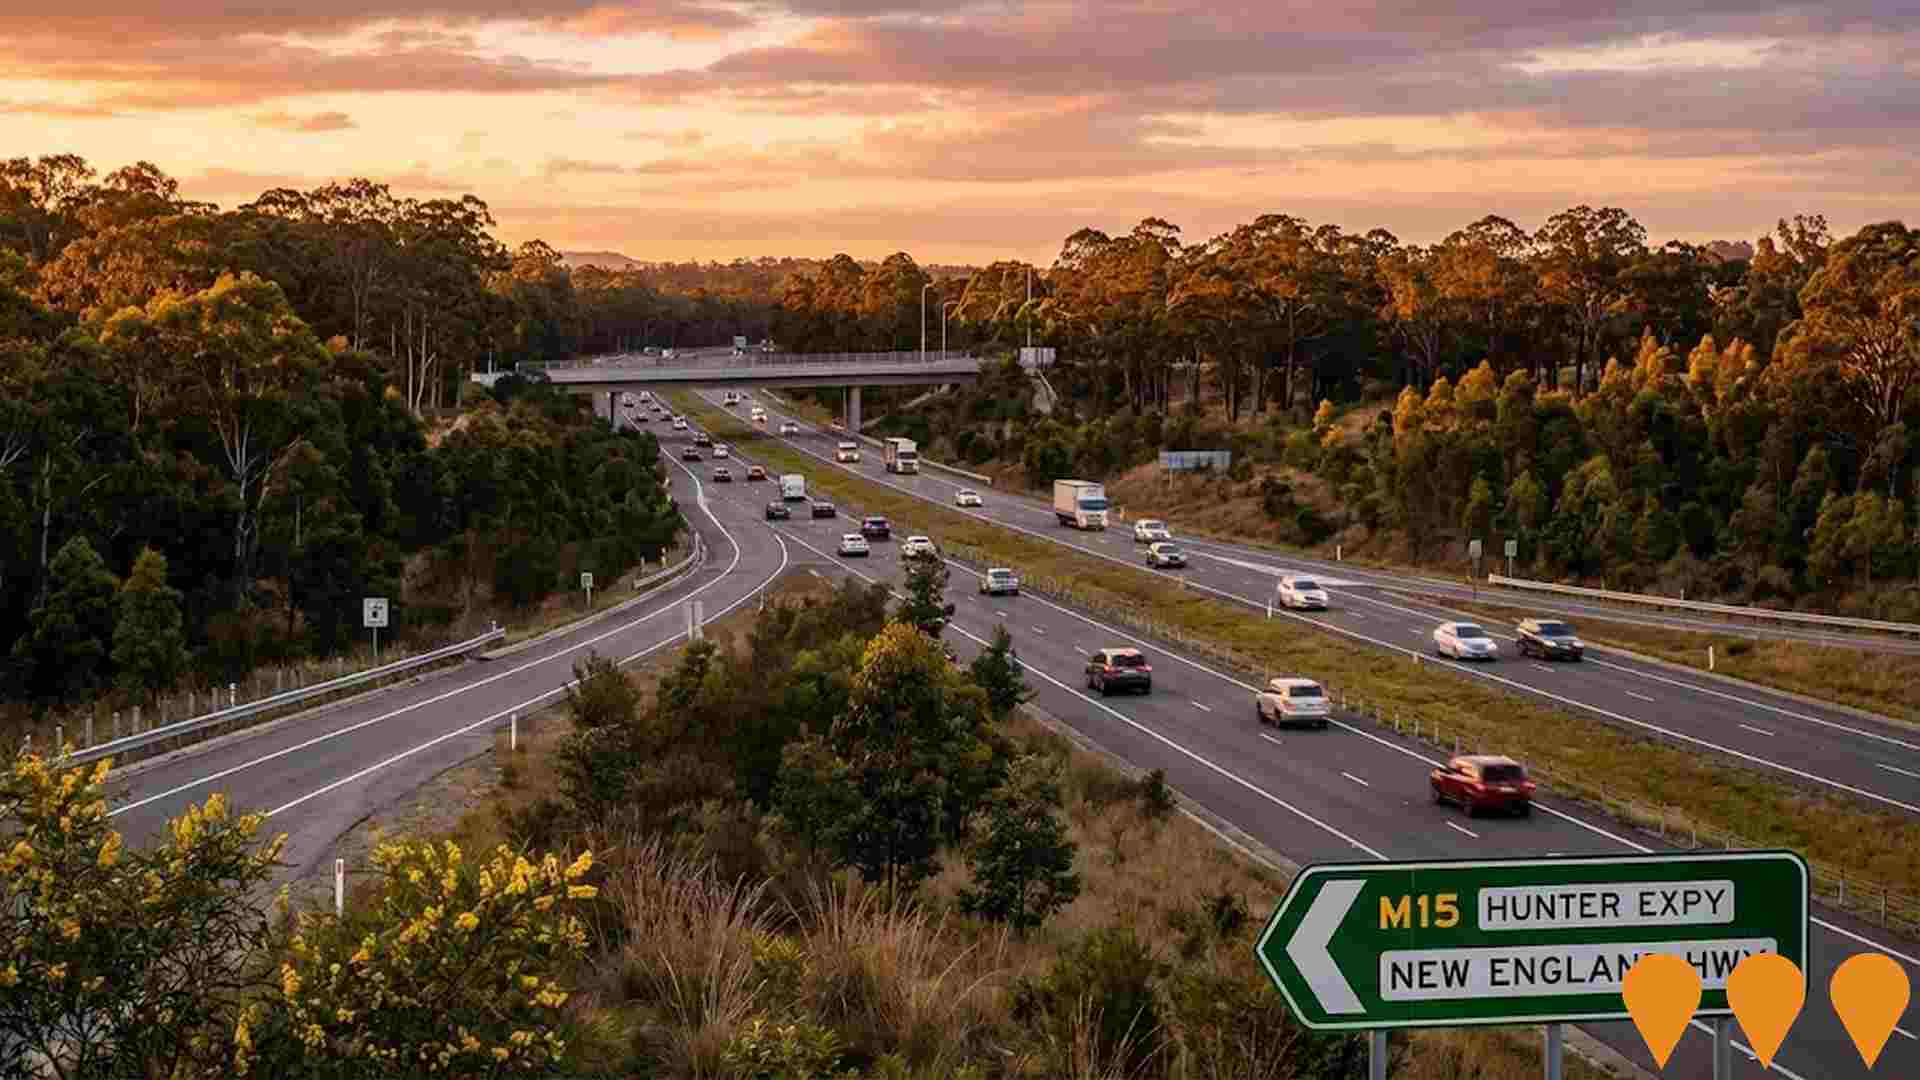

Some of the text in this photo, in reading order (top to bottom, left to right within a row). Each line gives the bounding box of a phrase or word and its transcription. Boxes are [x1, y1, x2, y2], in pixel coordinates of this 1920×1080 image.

[1379, 889, 1726, 929] M15 HUNTER EXPY
[1391, 949, 1767, 990] NEW ENGLAN HW
